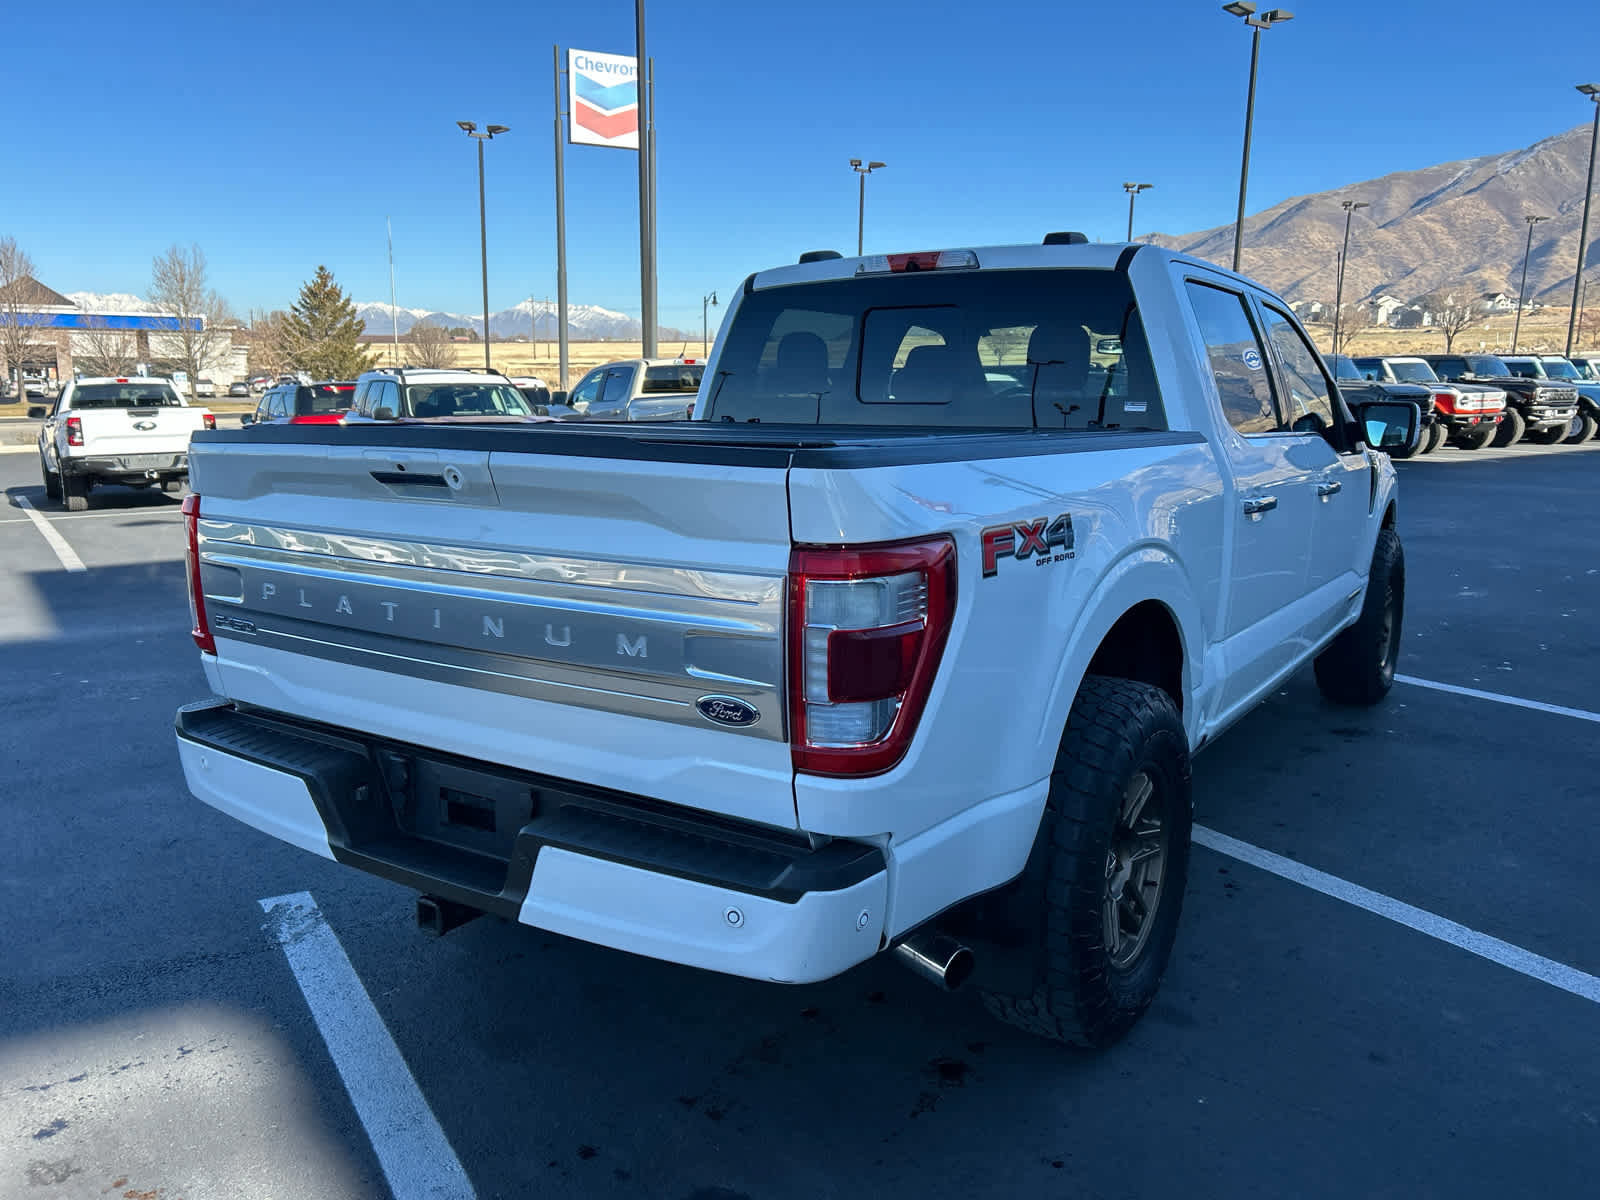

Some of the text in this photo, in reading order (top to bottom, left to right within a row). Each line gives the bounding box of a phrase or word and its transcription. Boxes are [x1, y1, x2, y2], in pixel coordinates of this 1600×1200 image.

[980, 512, 1074, 579] FX4
[1036, 551, 1075, 567] OFF ROAD
[262, 582, 648, 658] PLATINUM
[708, 700, 743, 721] Ford
